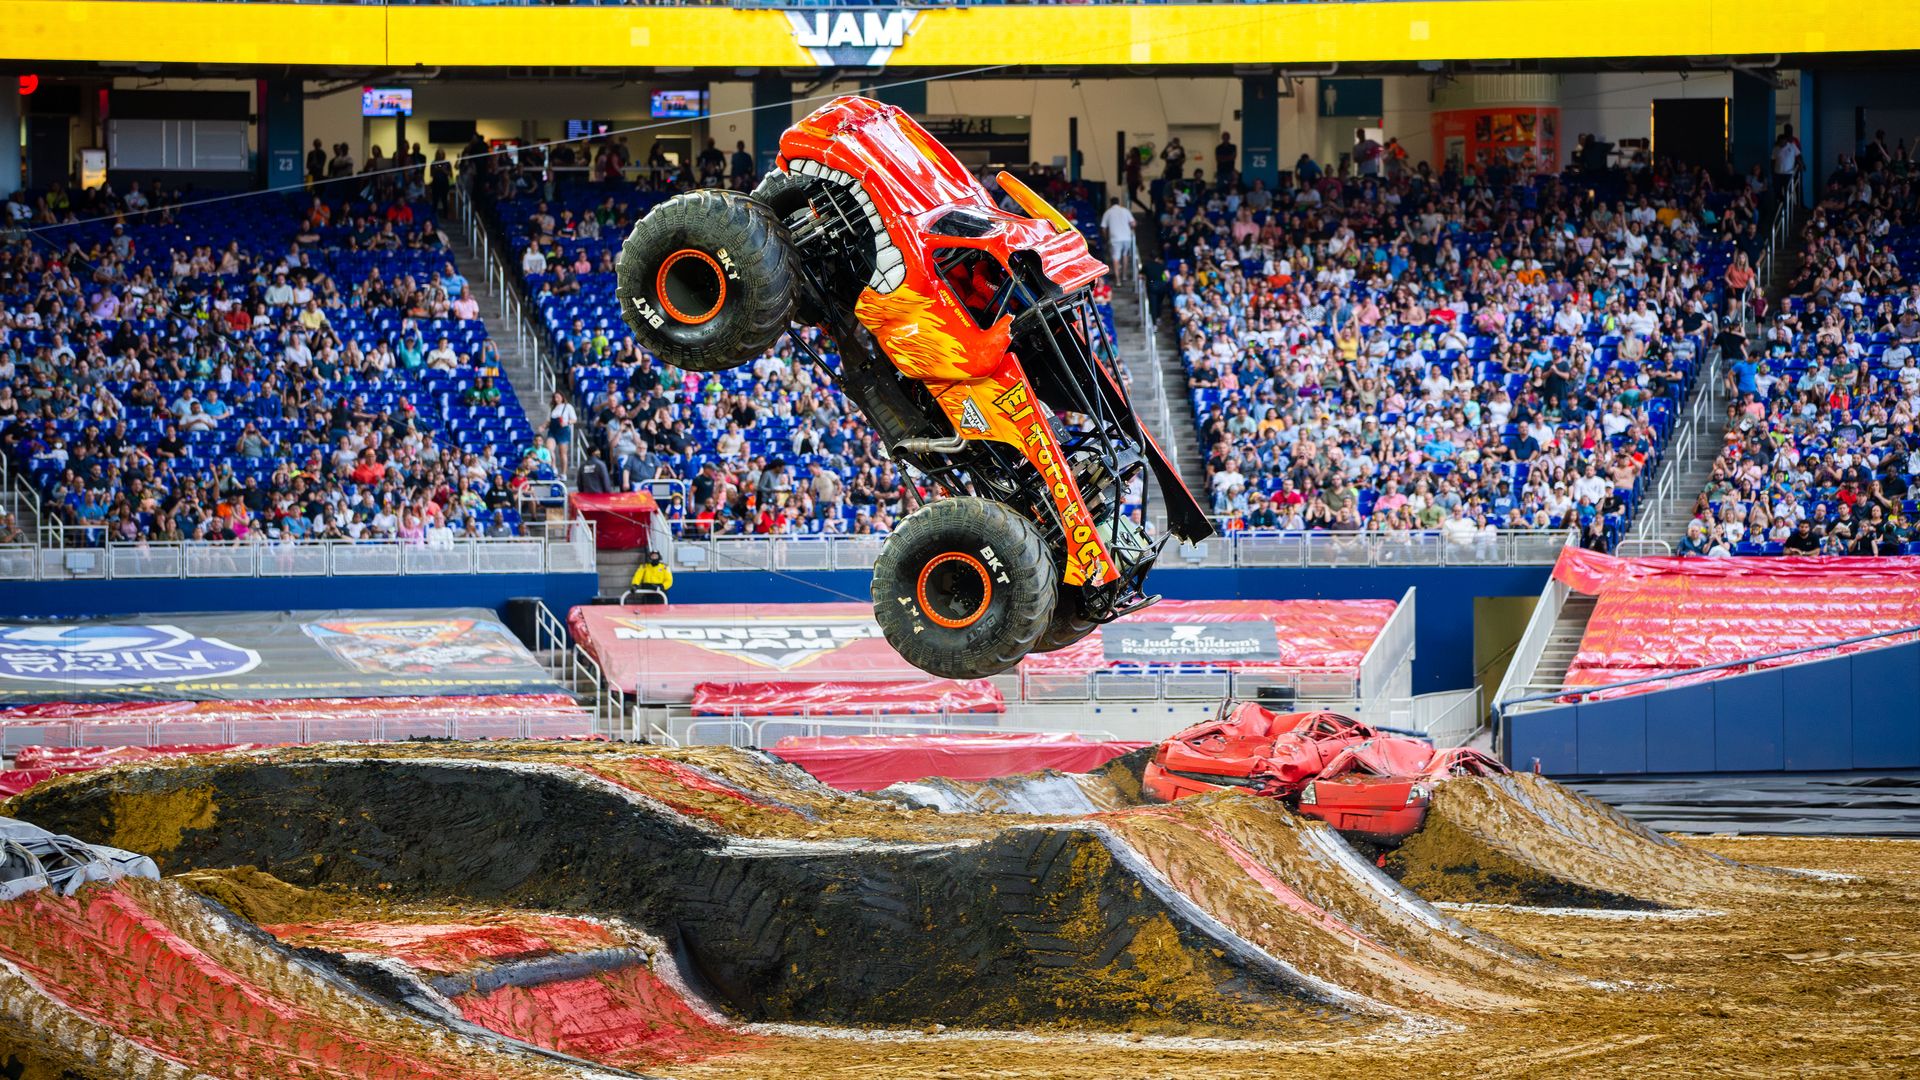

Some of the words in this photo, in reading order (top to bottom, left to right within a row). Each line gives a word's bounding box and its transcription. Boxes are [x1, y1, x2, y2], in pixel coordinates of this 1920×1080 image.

[797, 12, 904, 47] JAM
[279, 158, 293, 171] 23
[631, 296, 665, 330] BKT
[979, 545, 1011, 585] BKT
[703, 638, 836, 650] JAM
[1121, 638, 1142, 648] St.
[1143, 638, 1179, 648] Jude
[1180, 637, 1260, 648] Children's
